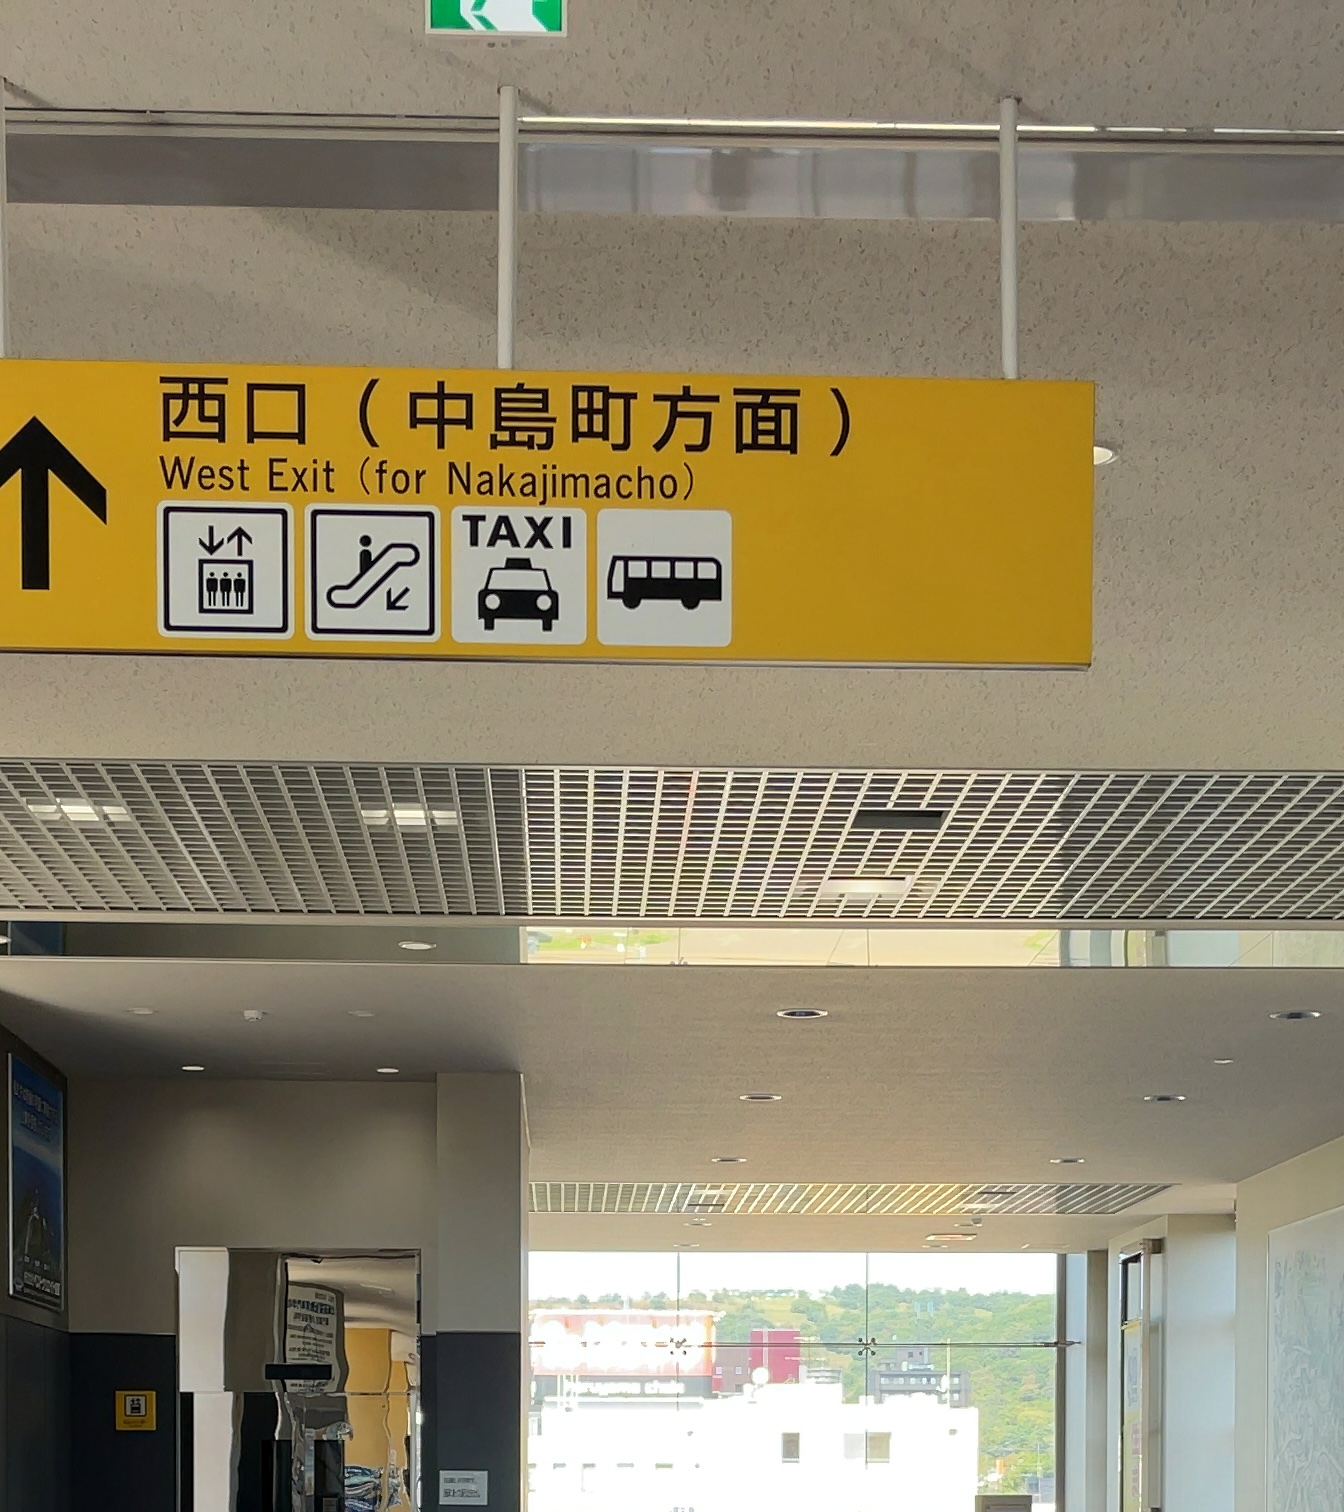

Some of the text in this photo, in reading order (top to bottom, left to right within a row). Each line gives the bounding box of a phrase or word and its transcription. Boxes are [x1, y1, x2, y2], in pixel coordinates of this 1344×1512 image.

[159, 455, 695, 506] West Exit (for Nakajimacho)
[461, 514, 573, 549] TAXI
